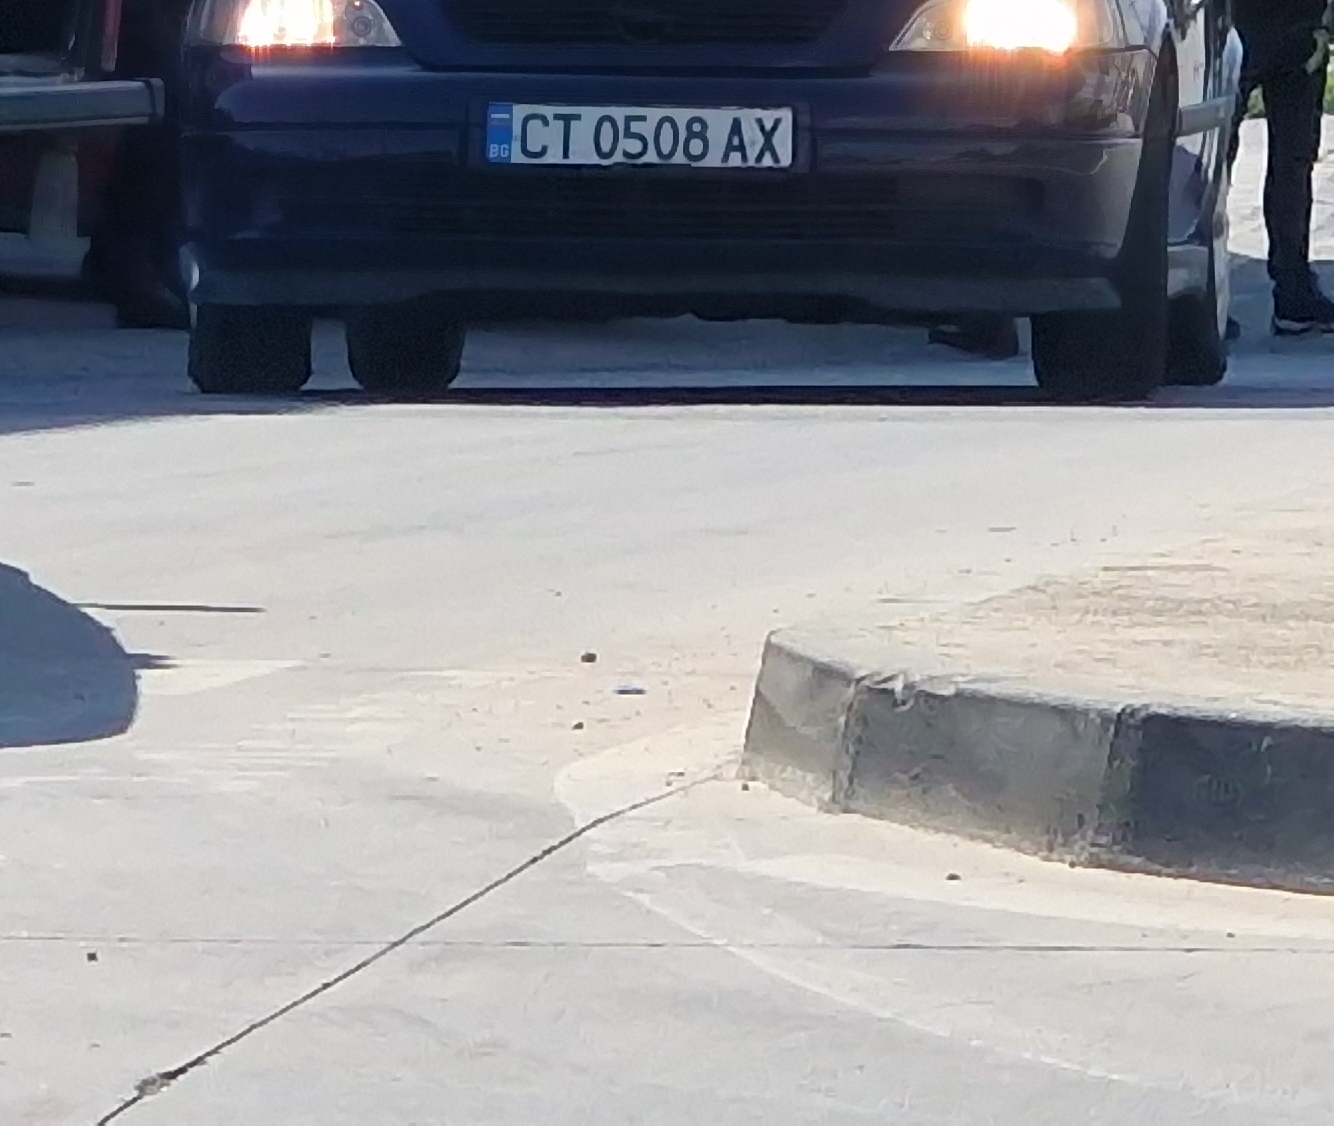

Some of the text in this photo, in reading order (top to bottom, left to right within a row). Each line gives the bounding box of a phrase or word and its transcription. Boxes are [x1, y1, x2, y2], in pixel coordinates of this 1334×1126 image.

[489, 144, 509, 158] BG
[520, 113, 783, 164] CT 0508 AX
